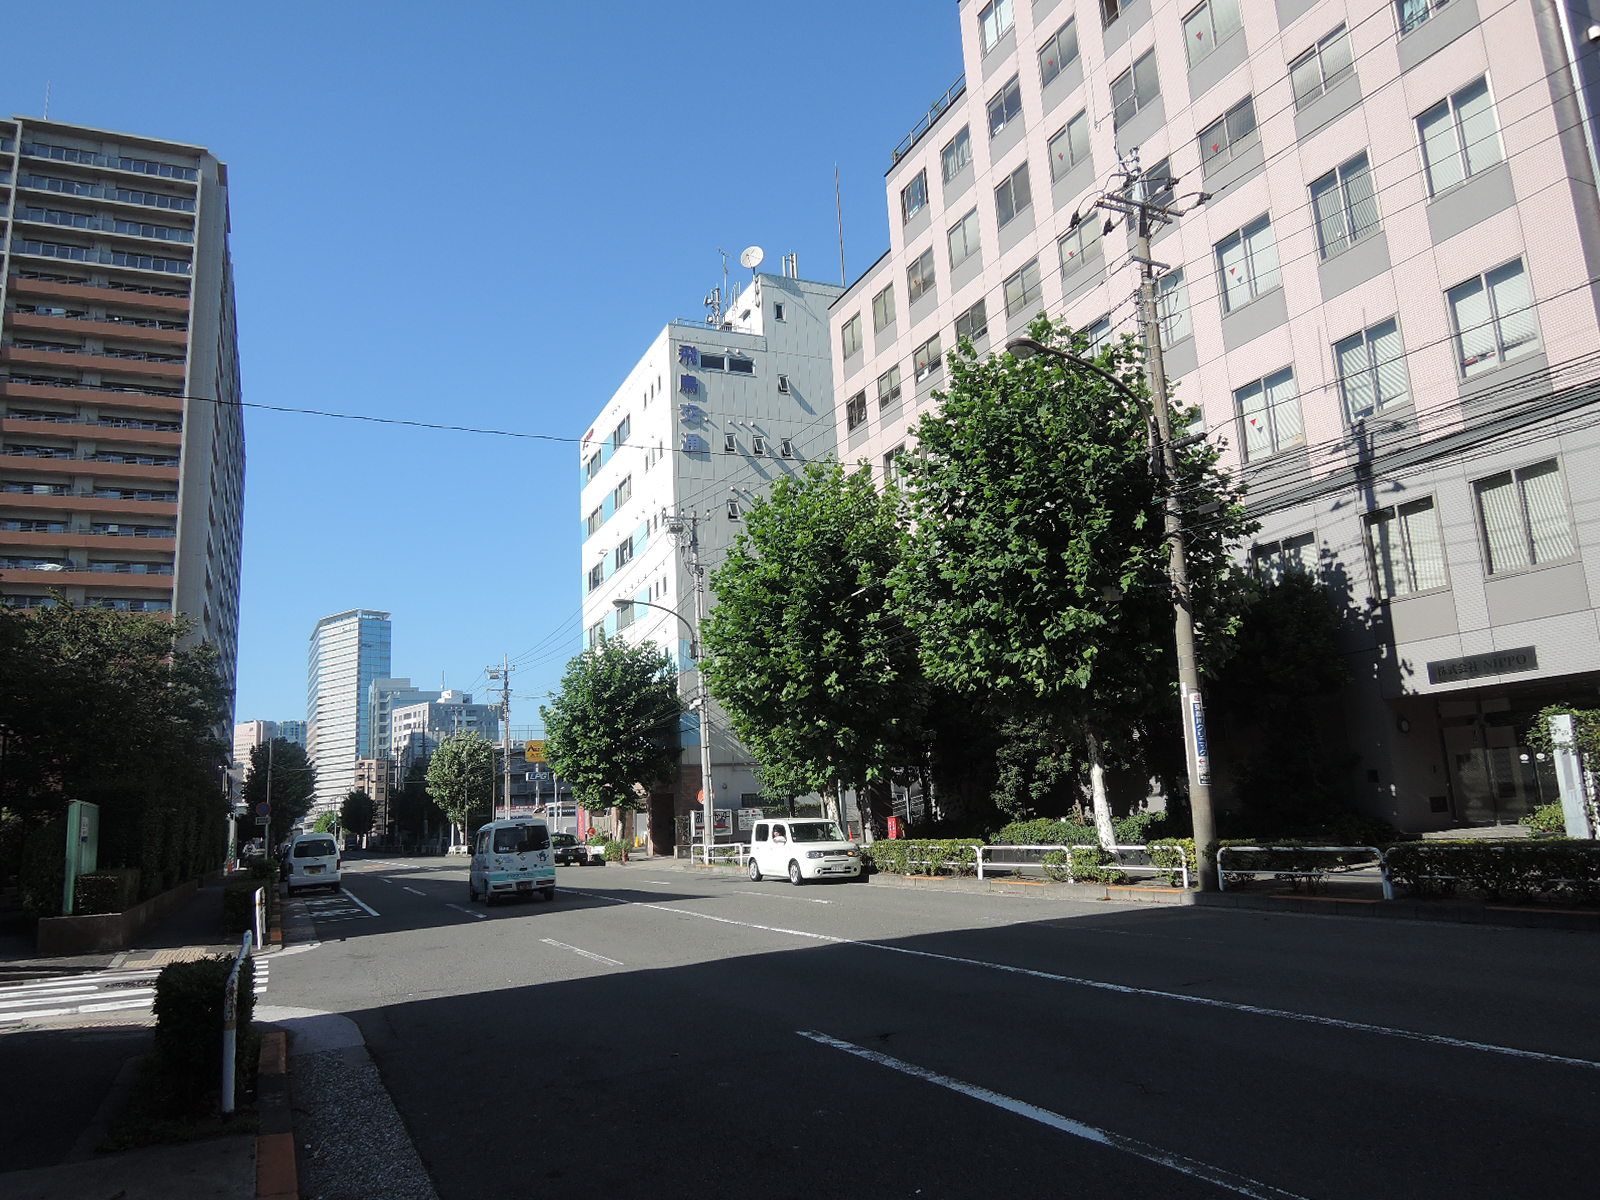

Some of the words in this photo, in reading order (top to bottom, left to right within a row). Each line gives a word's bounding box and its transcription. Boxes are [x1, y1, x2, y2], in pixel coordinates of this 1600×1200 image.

[1438, 660, 1478, 677] 株式会社
[1484, 654, 1527, 670] NIPPO
[530, 771, 548, 780] LPG
